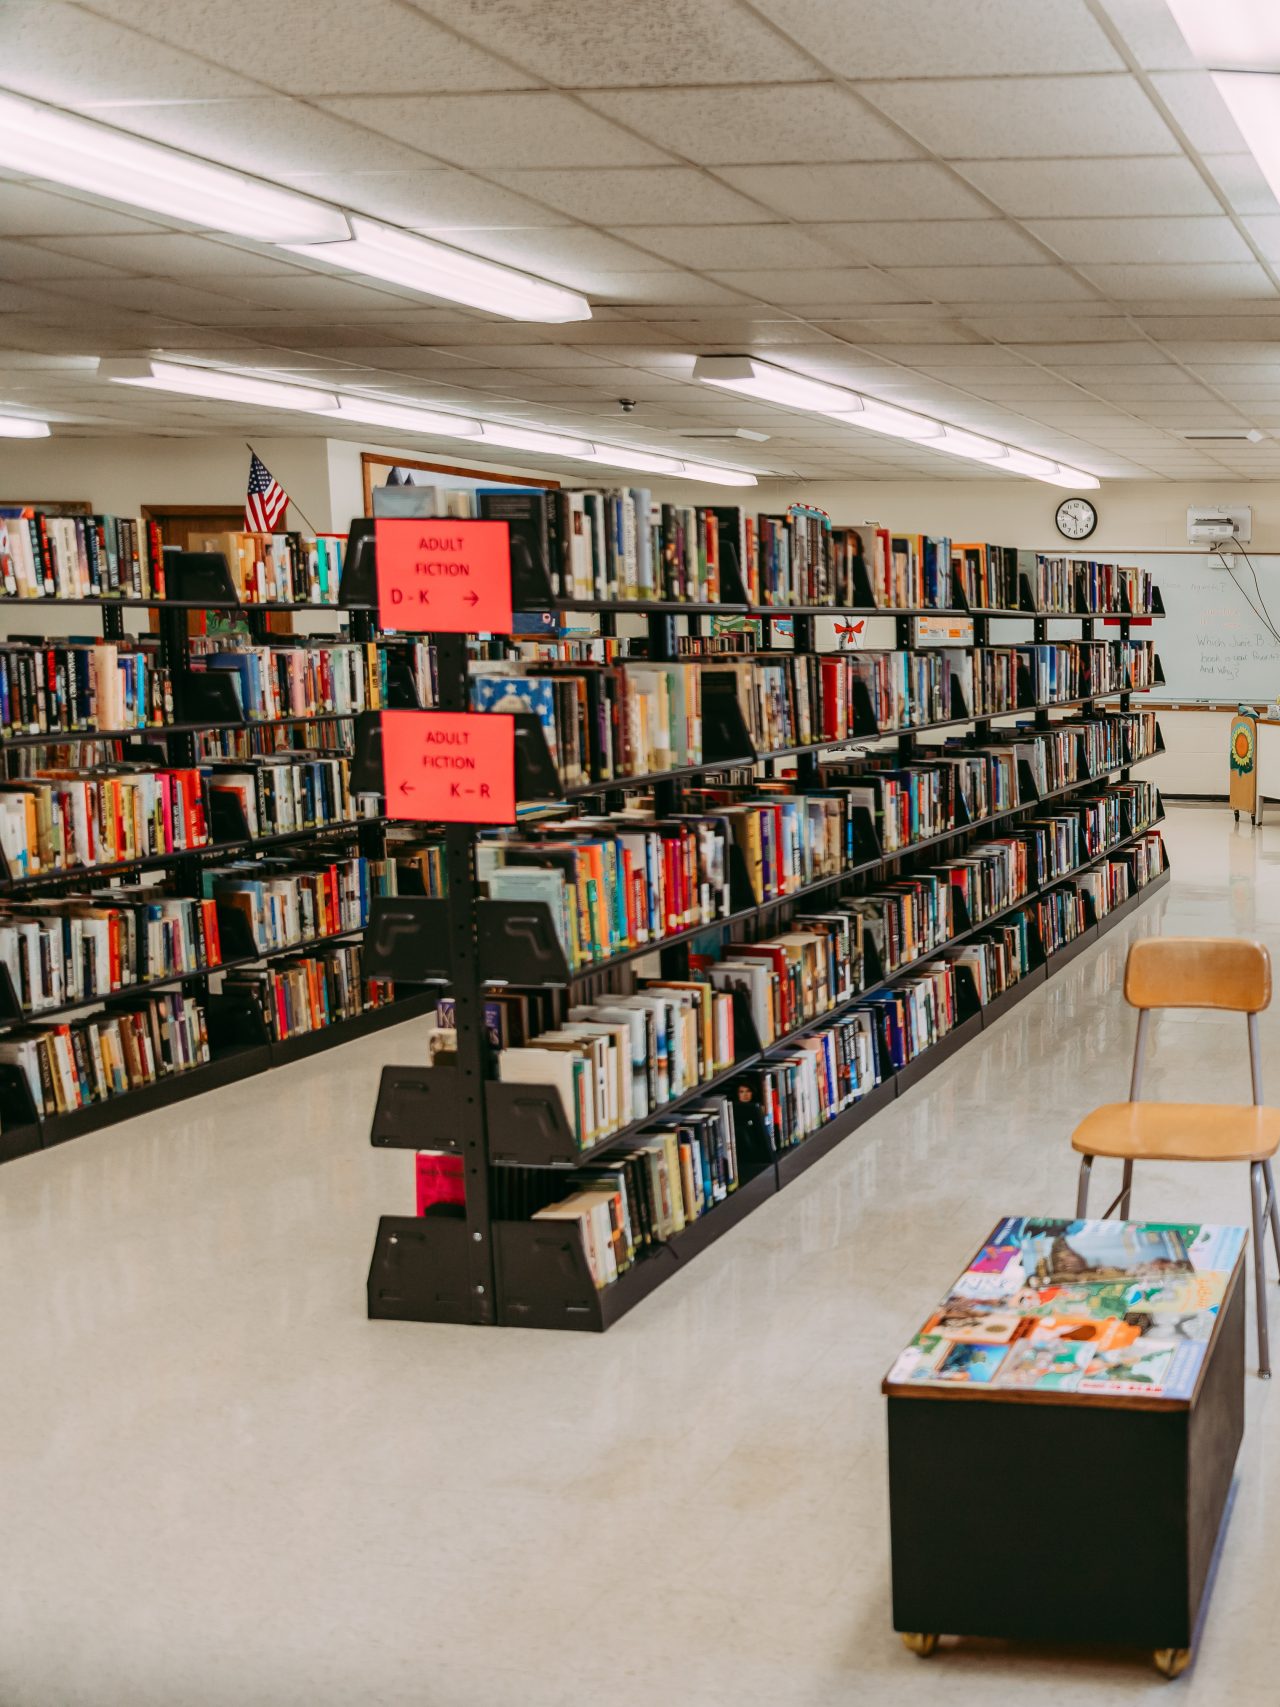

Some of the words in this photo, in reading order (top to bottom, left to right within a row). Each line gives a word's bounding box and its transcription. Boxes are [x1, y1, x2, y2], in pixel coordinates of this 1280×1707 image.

[419, 537, 465, 551] ADULT
[415, 562, 470, 577] FICTION
[391, 589, 403, 604] D
[419, 590, 430, 605] K
[426, 732, 470, 745] ADULT
[422, 755, 475, 770] FICTION
[450, 783, 461, 797] K
[480, 783, 491, 798] R
